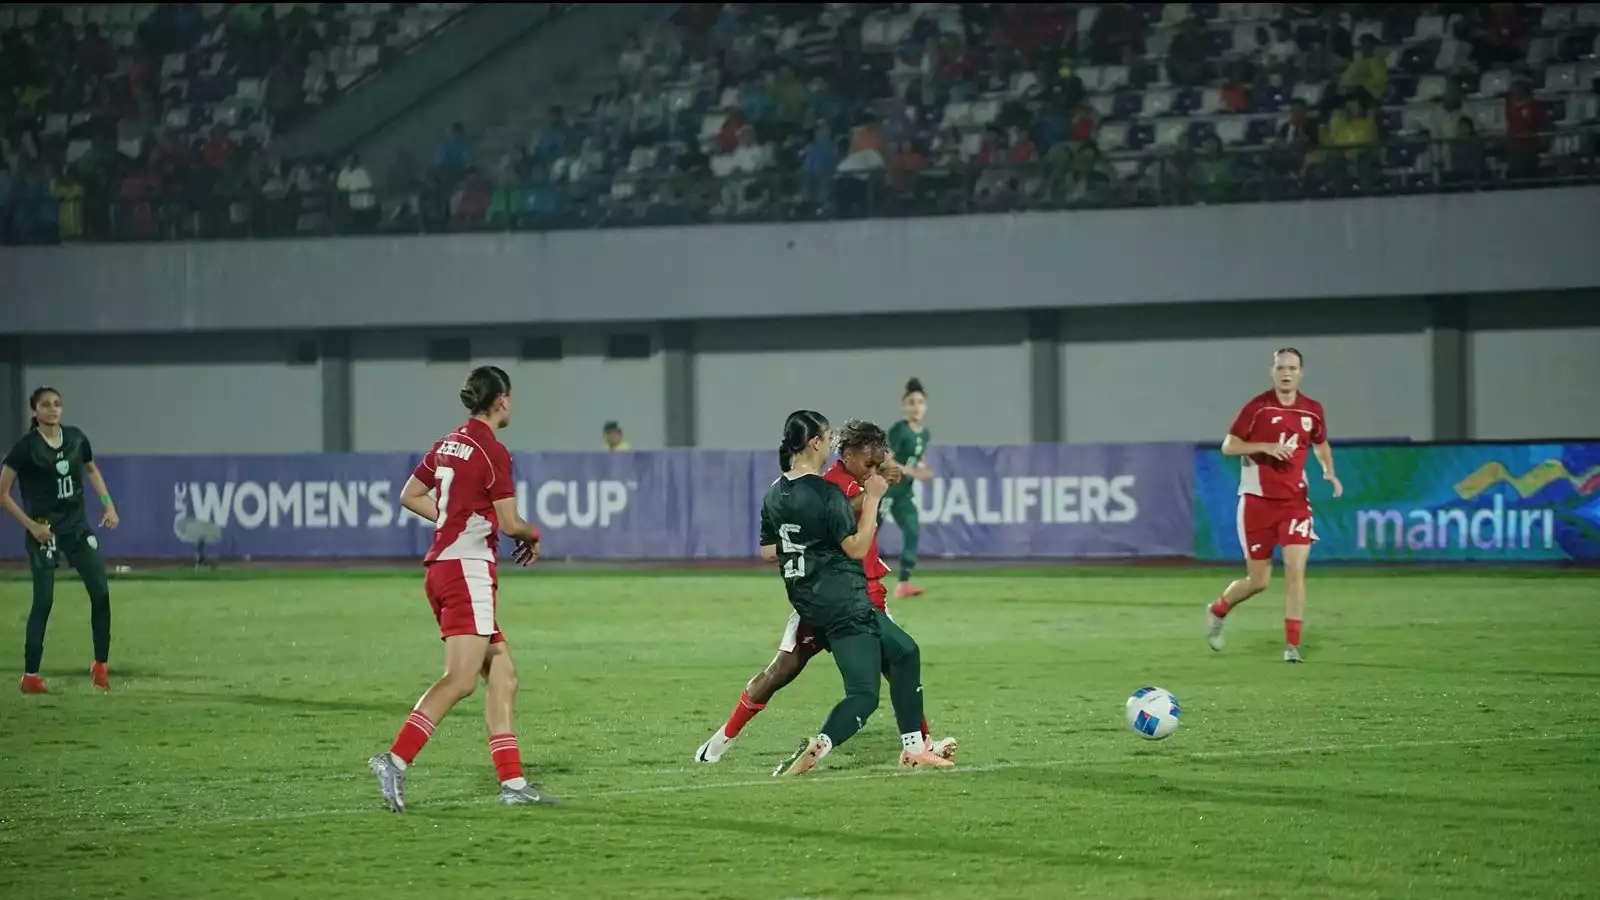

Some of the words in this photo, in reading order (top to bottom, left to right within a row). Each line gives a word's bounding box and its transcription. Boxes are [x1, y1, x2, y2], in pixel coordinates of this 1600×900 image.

[1278, 432, 1299, 453] 14
[57, 475, 74, 498] 10
[189, 481, 393, 529] WOMEN'S
[536, 480, 628, 528] CUP
[434, 466, 455, 529] 7
[880, 475, 1138, 523] UALIFIERS
[1288, 518, 1311, 538] 14
[1356, 493, 1554, 548] mandiri
[779, 523, 807, 578] 5
